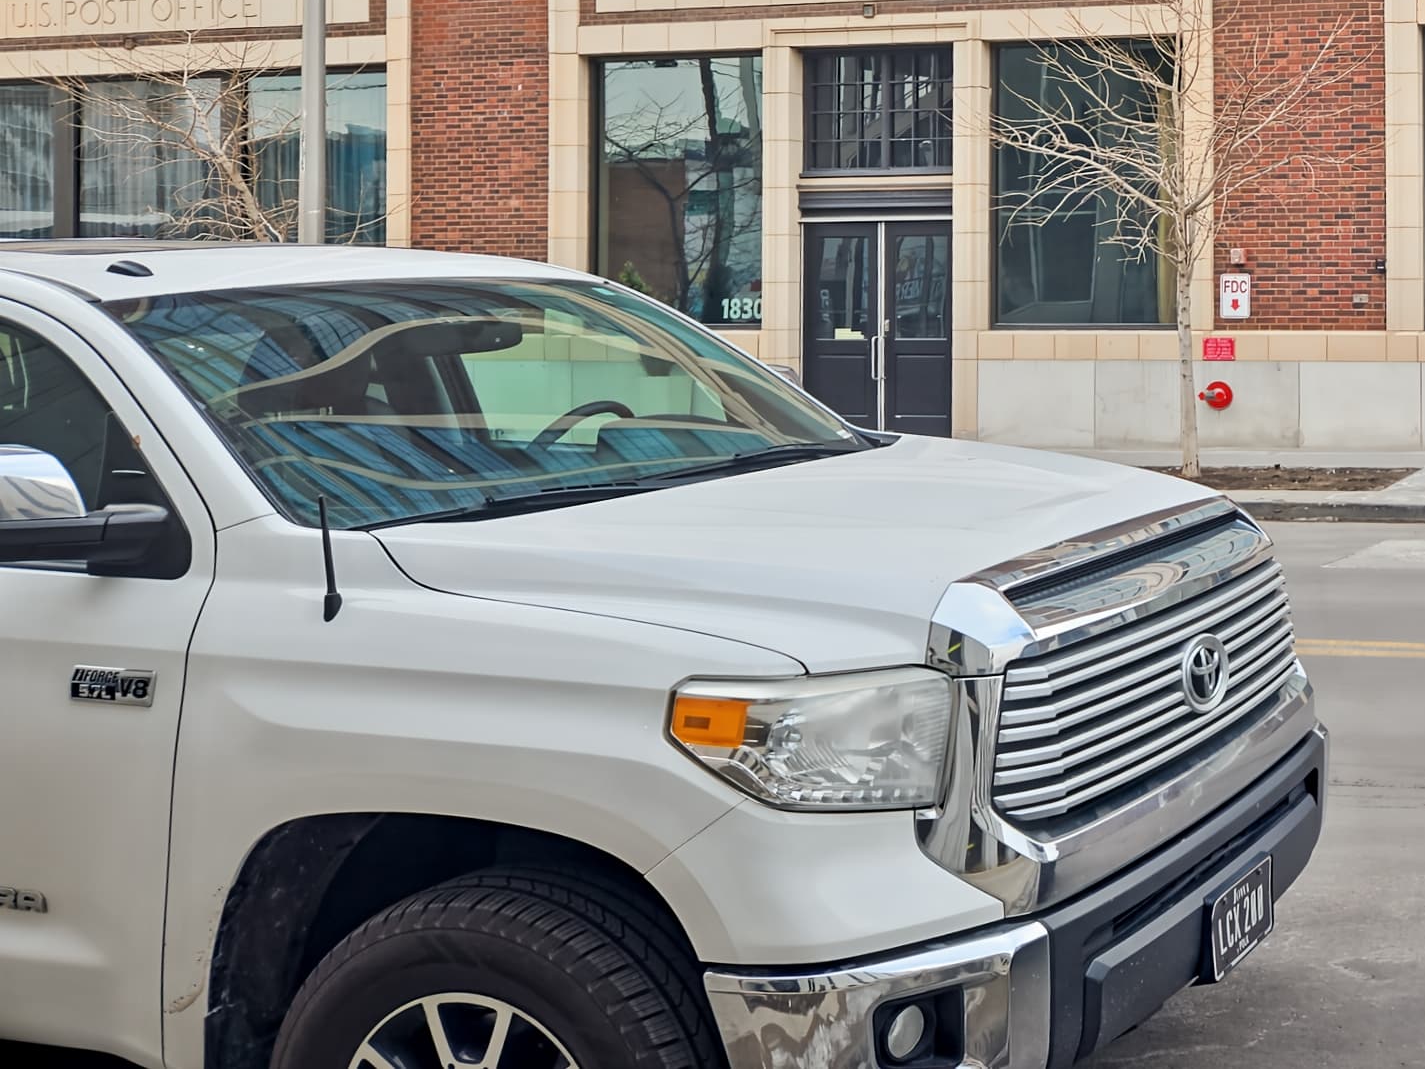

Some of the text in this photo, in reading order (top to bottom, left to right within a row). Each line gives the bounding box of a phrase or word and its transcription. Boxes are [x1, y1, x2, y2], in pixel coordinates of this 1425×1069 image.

[1223, 280, 1248, 293] FDC
[721, 297, 763, 320] 1830
[120, 677, 150, 699] V8
[1218, 903, 1242, 956] LCX
